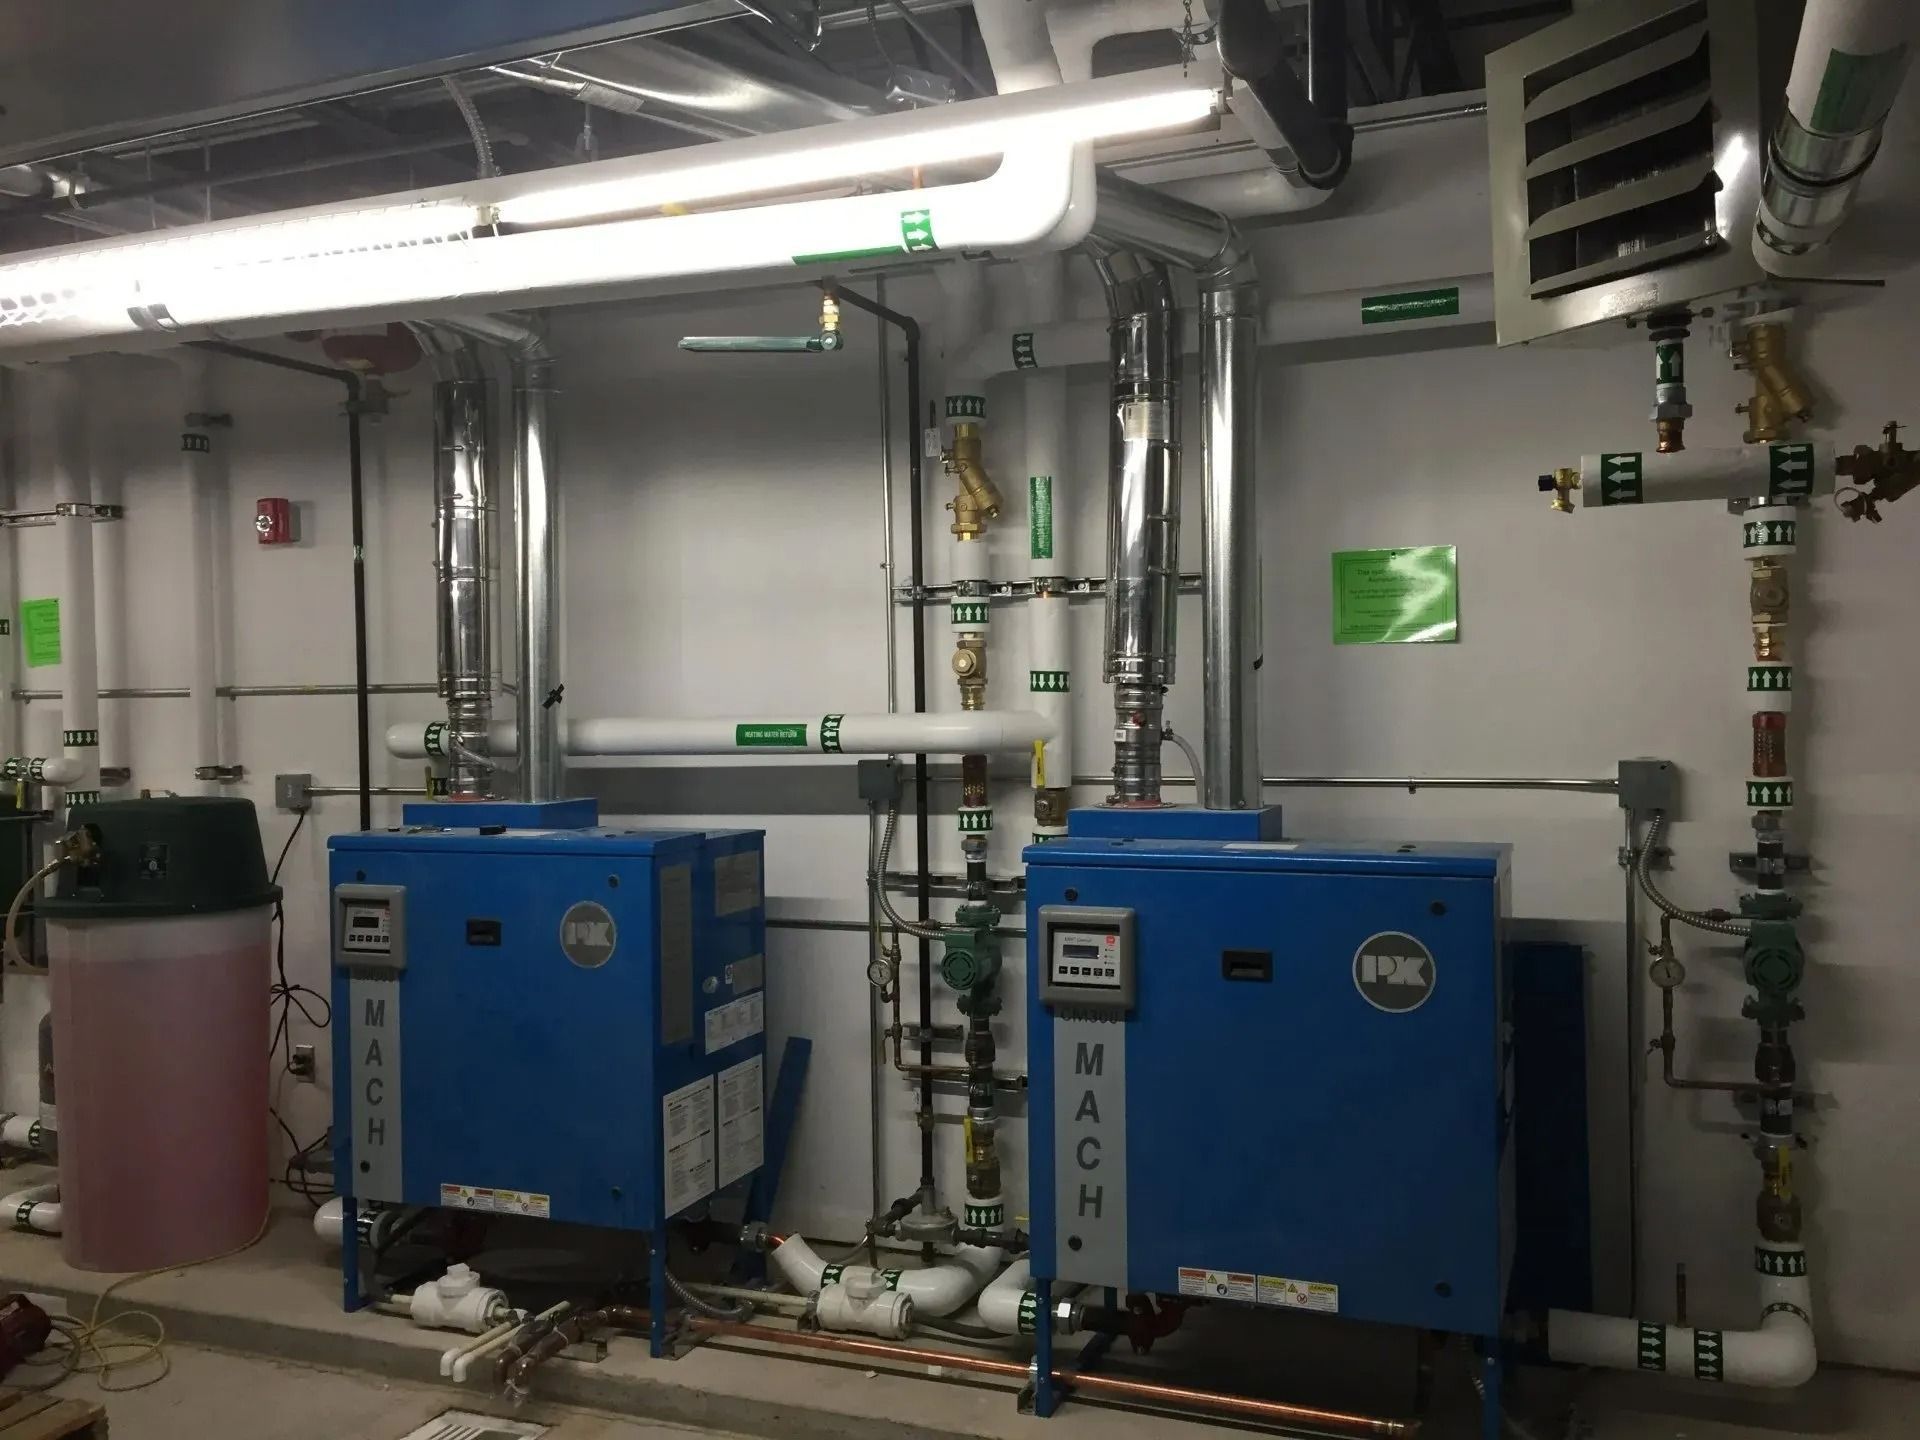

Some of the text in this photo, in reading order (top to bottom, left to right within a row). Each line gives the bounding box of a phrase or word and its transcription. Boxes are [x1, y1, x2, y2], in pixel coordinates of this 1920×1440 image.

[1361, 954, 1427, 986] PK
[365, 998, 386, 1147] MACH
[1074, 1042, 1104, 1218] MACH
